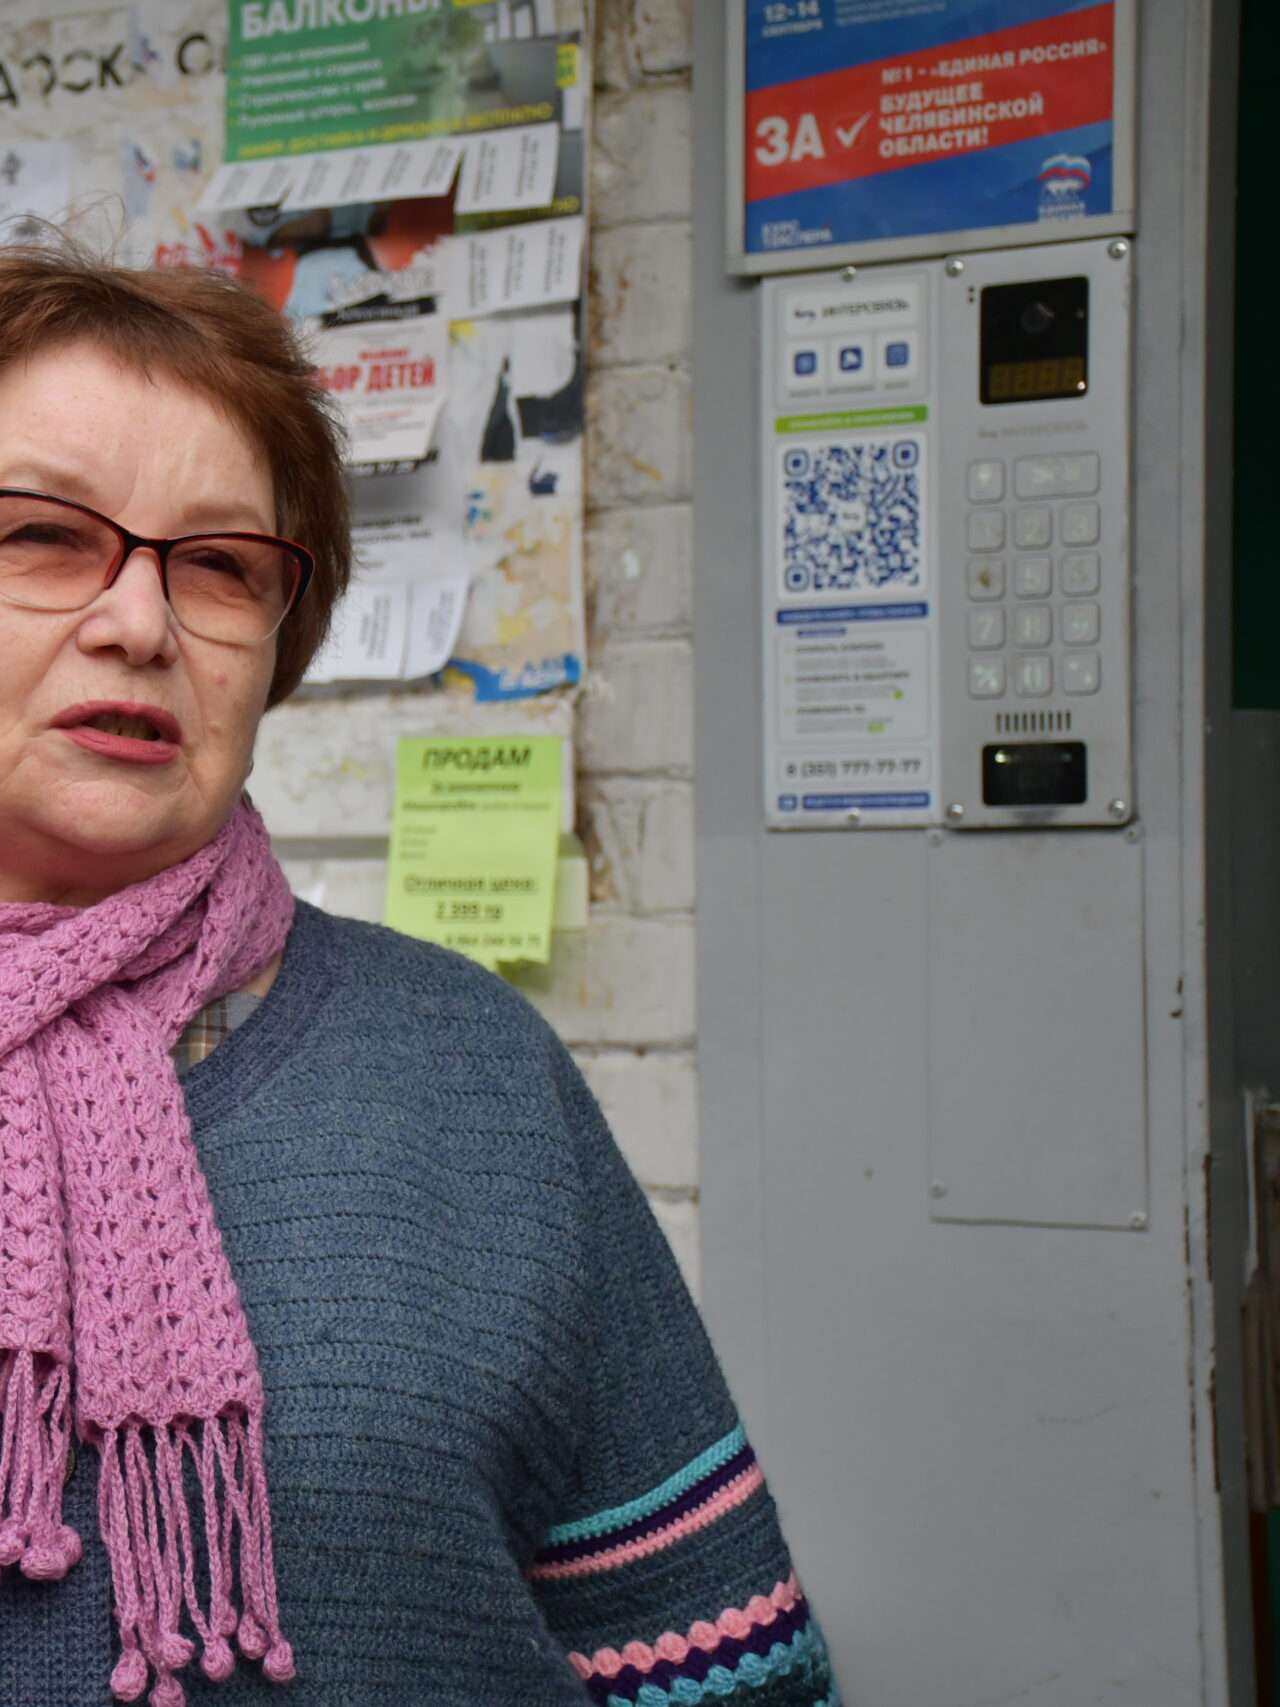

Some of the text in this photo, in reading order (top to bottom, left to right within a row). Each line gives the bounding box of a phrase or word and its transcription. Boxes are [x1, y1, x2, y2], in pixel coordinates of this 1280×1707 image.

[879, 92, 1044, 135] ЧЕЛЯБИНСКОЙ
[880, 82, 984, 113] БУДУЩЕЕ
[755, 113, 825, 167] ЗА
[879, 129, 989, 159] ОБЛАСТИ!
[314, 363, 362, 392] БОР
[364, 355, 435, 395] ДЕТЕЙ
[421, 745, 531, 772] ПРОДАМ
